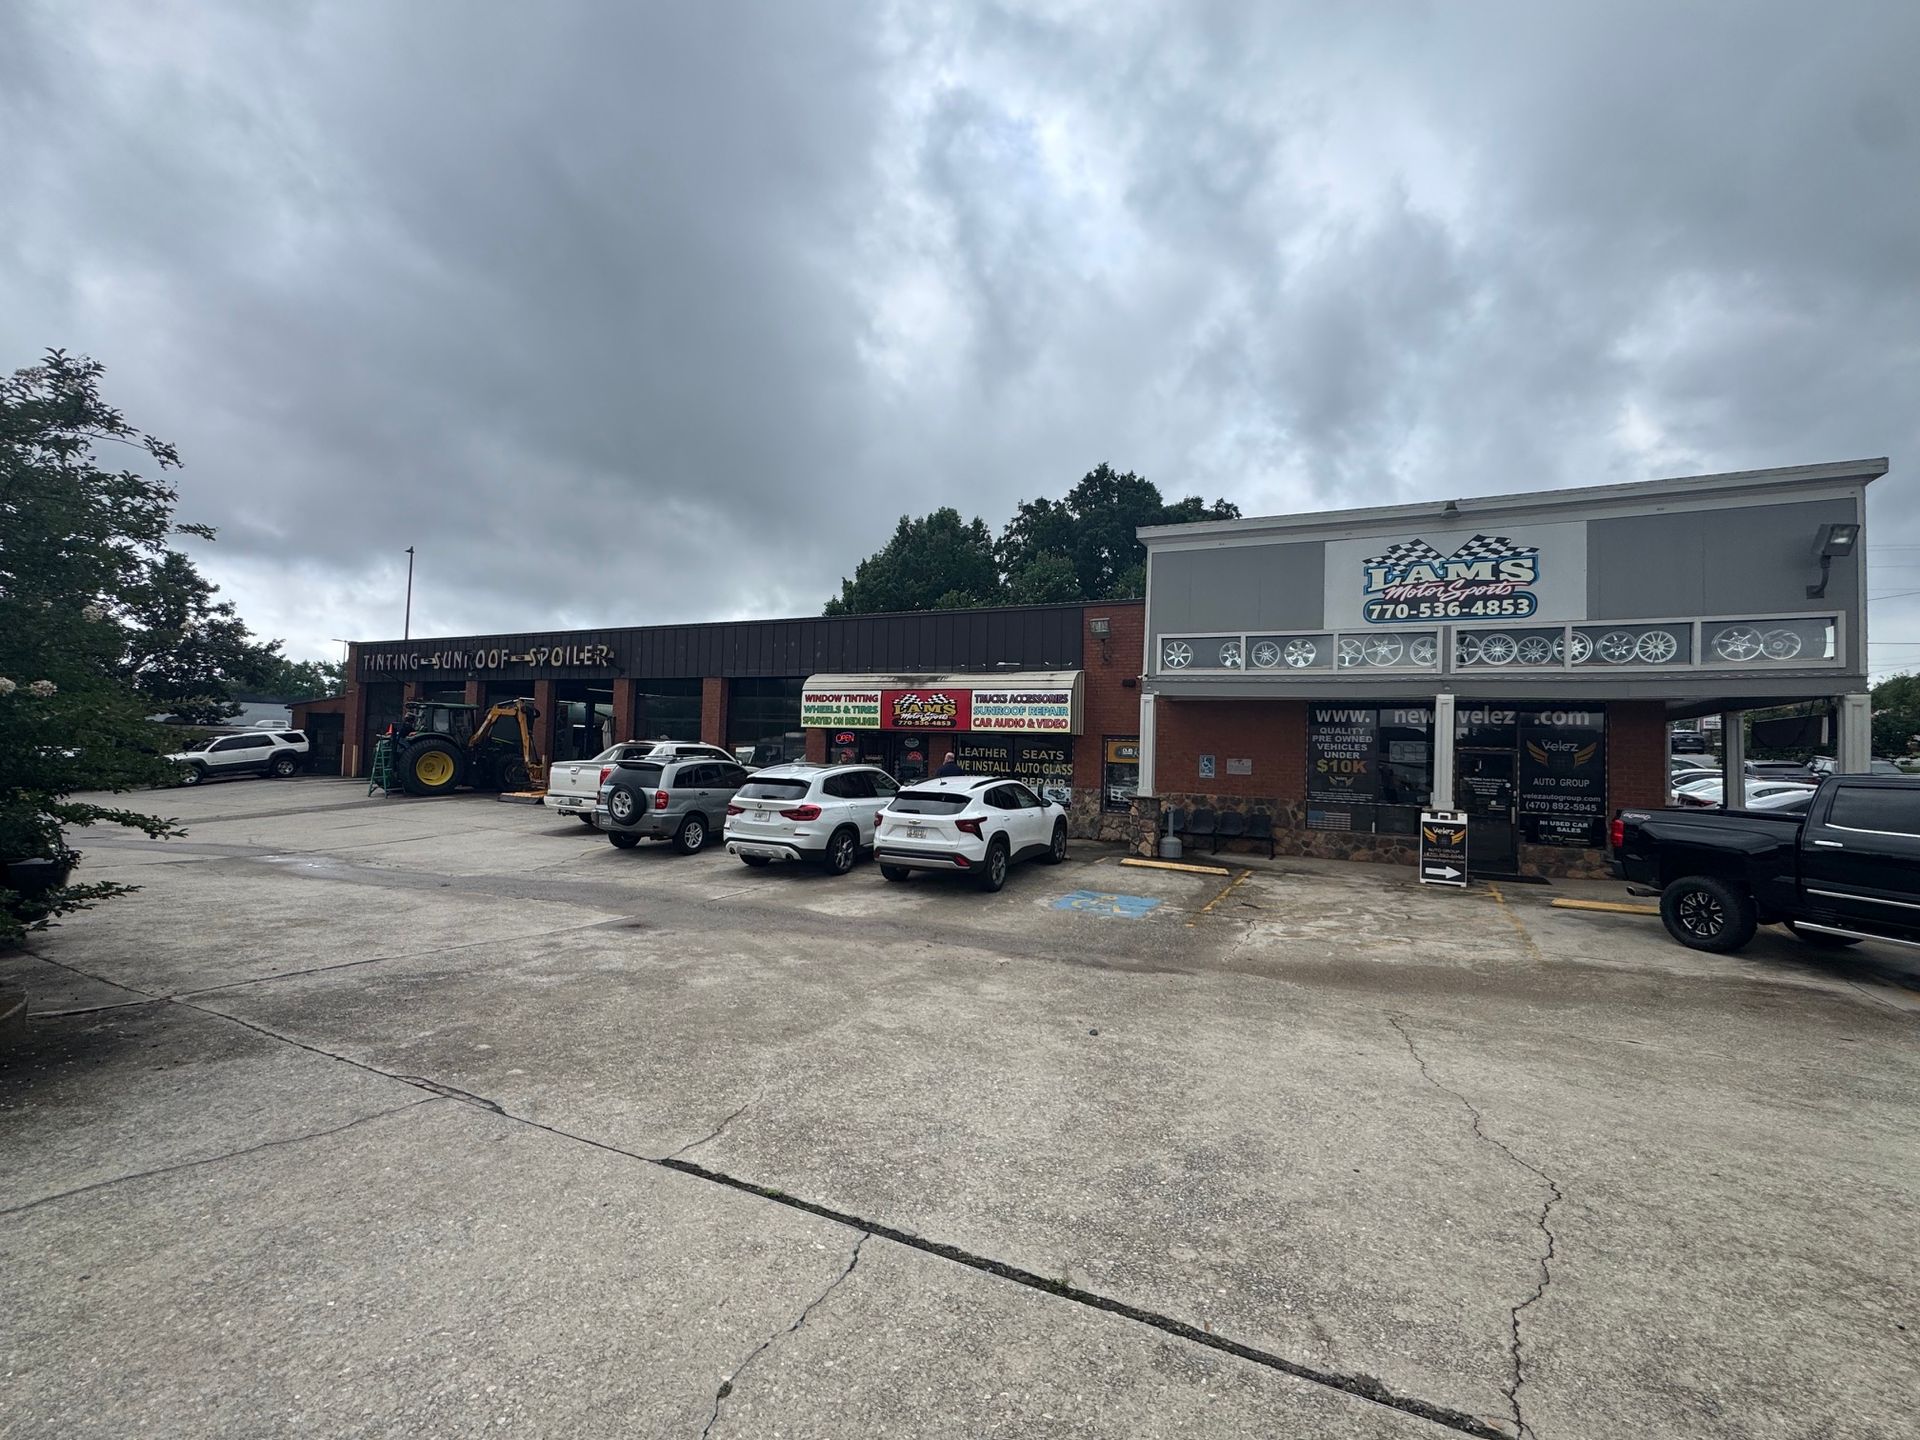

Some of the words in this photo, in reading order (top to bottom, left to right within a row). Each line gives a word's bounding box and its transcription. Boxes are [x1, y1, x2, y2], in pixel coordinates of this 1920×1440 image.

[1367, 557, 1535, 592] LAMS
[1368, 599, 1530, 619] 770-536-4853
[805, 694, 843, 703] WINDOW
[844, 694, 878, 703] TINTING
[974, 694, 1008, 704] TRUCKS
[1009, 694, 1068, 704] ACCESSORIES
[804, 705, 841, 714] WHEELS
[843, 705, 850, 714] &
[851, 705, 878, 714] TIRES
[894, 704, 956, 716] LAMS
[973, 705, 1026, 716] SUNROOF
[1028, 706, 1069, 717] REPAIR
[833, 716, 844, 725] ON
[1316, 709, 1370, 723] www.
[973, 718, 992, 728] CAR
[994, 718, 1026, 728] AUDIO
[1027, 719, 1036, 729] &
[1037, 718, 1069, 729] VIDEO
[1320, 727, 1365, 735] QUALITY
[836, 733, 854, 743] OPEN
[1334, 735, 1373, 743] OWNED
[1317, 743, 1368, 751] VEHICLES
[1541, 739, 1579, 752] Velez
[958, 747, 1008, 758] LEATHER
[1022, 750, 1065, 760] SEATS
[1324, 751, 1360, 759] UNDER
[957, 760, 970, 771] WE
[972, 760, 1011, 773] INSTALL
[1014, 763, 1040, 774] AUTO
[1042, 764, 1073, 775] GLASS
[1316, 759, 1367, 774] $10K
[1021, 777, 1066, 787] REPAIR
[1532, 778, 1556, 787] AUTO
[1560, 779, 1590, 787] GROUP
[1525, 801, 1550, 811] (470)
[1552, 802, 1597, 812] 892-5945
